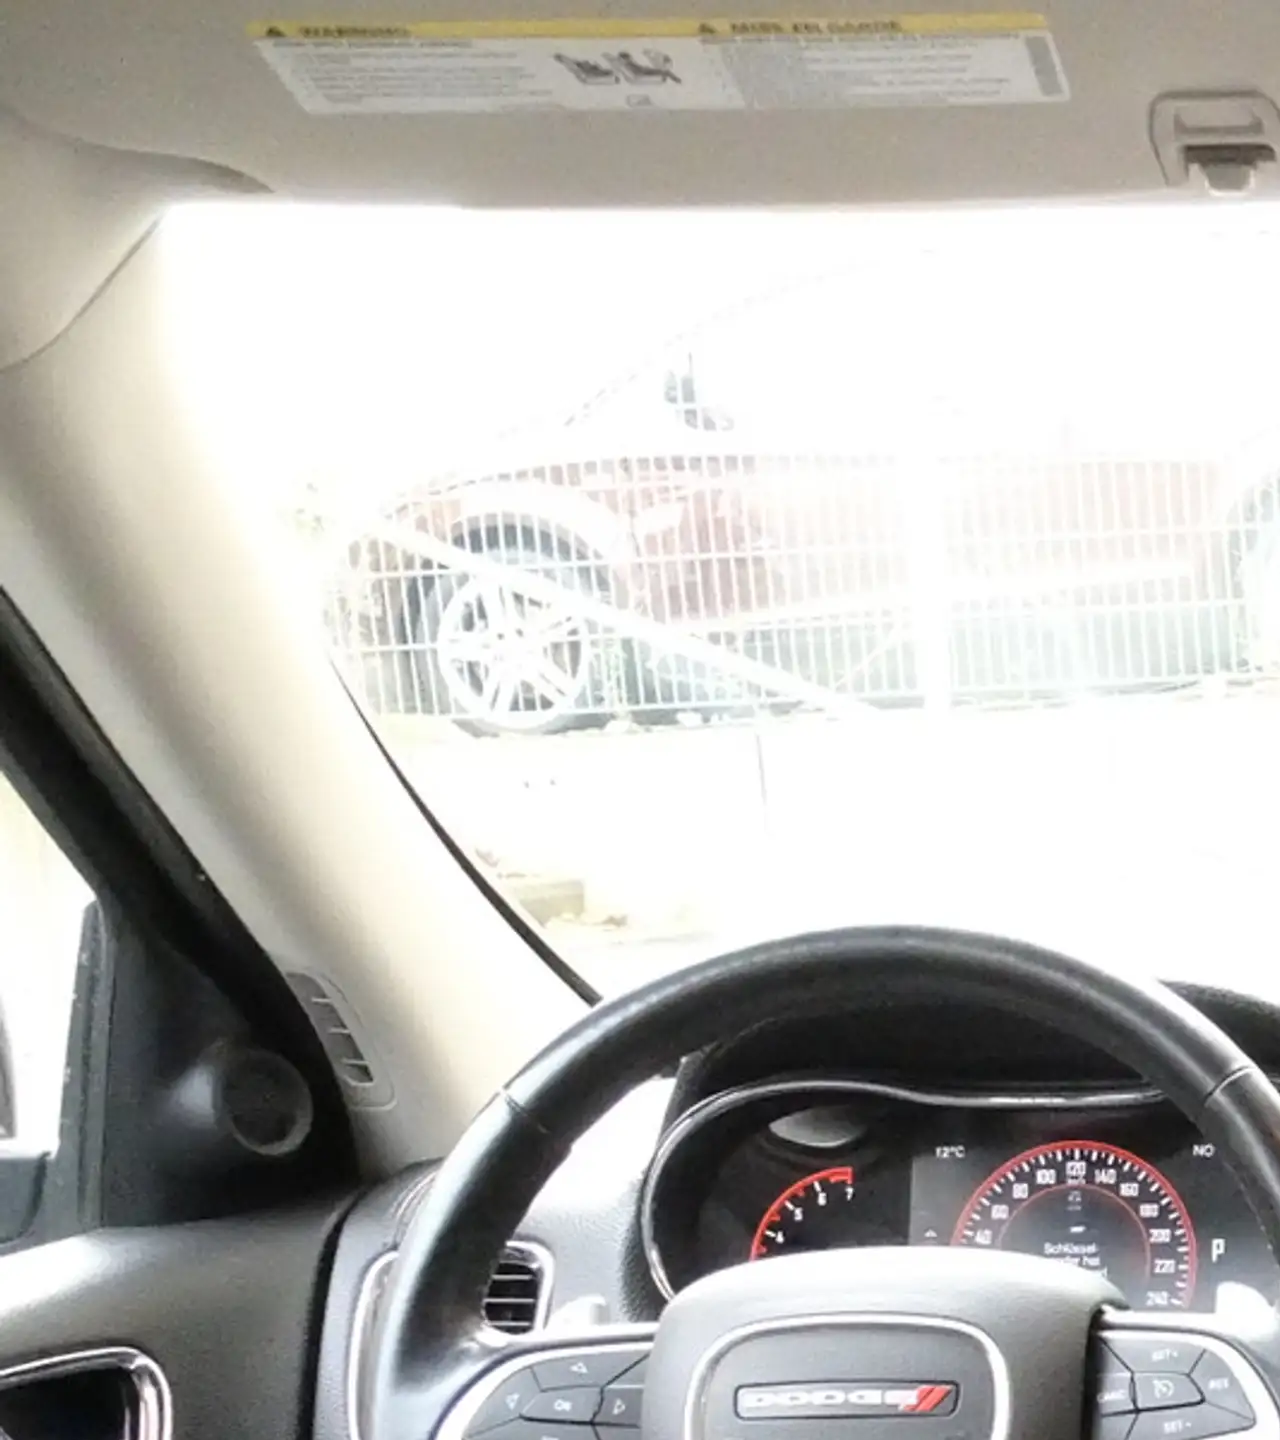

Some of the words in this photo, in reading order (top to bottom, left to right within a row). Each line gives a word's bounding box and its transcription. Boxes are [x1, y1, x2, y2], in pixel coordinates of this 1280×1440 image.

[817, 1192, 827, 1206] 6
[845, 1186, 854, 1201] 7
[794, 1206, 803, 1221] 5
[775, 1231, 785, 1244] 4
[975, 1229, 993, 1245] 40
[1211, 1238, 1226, 1263] P
[1154, 1259, 1176, 1274] 220
